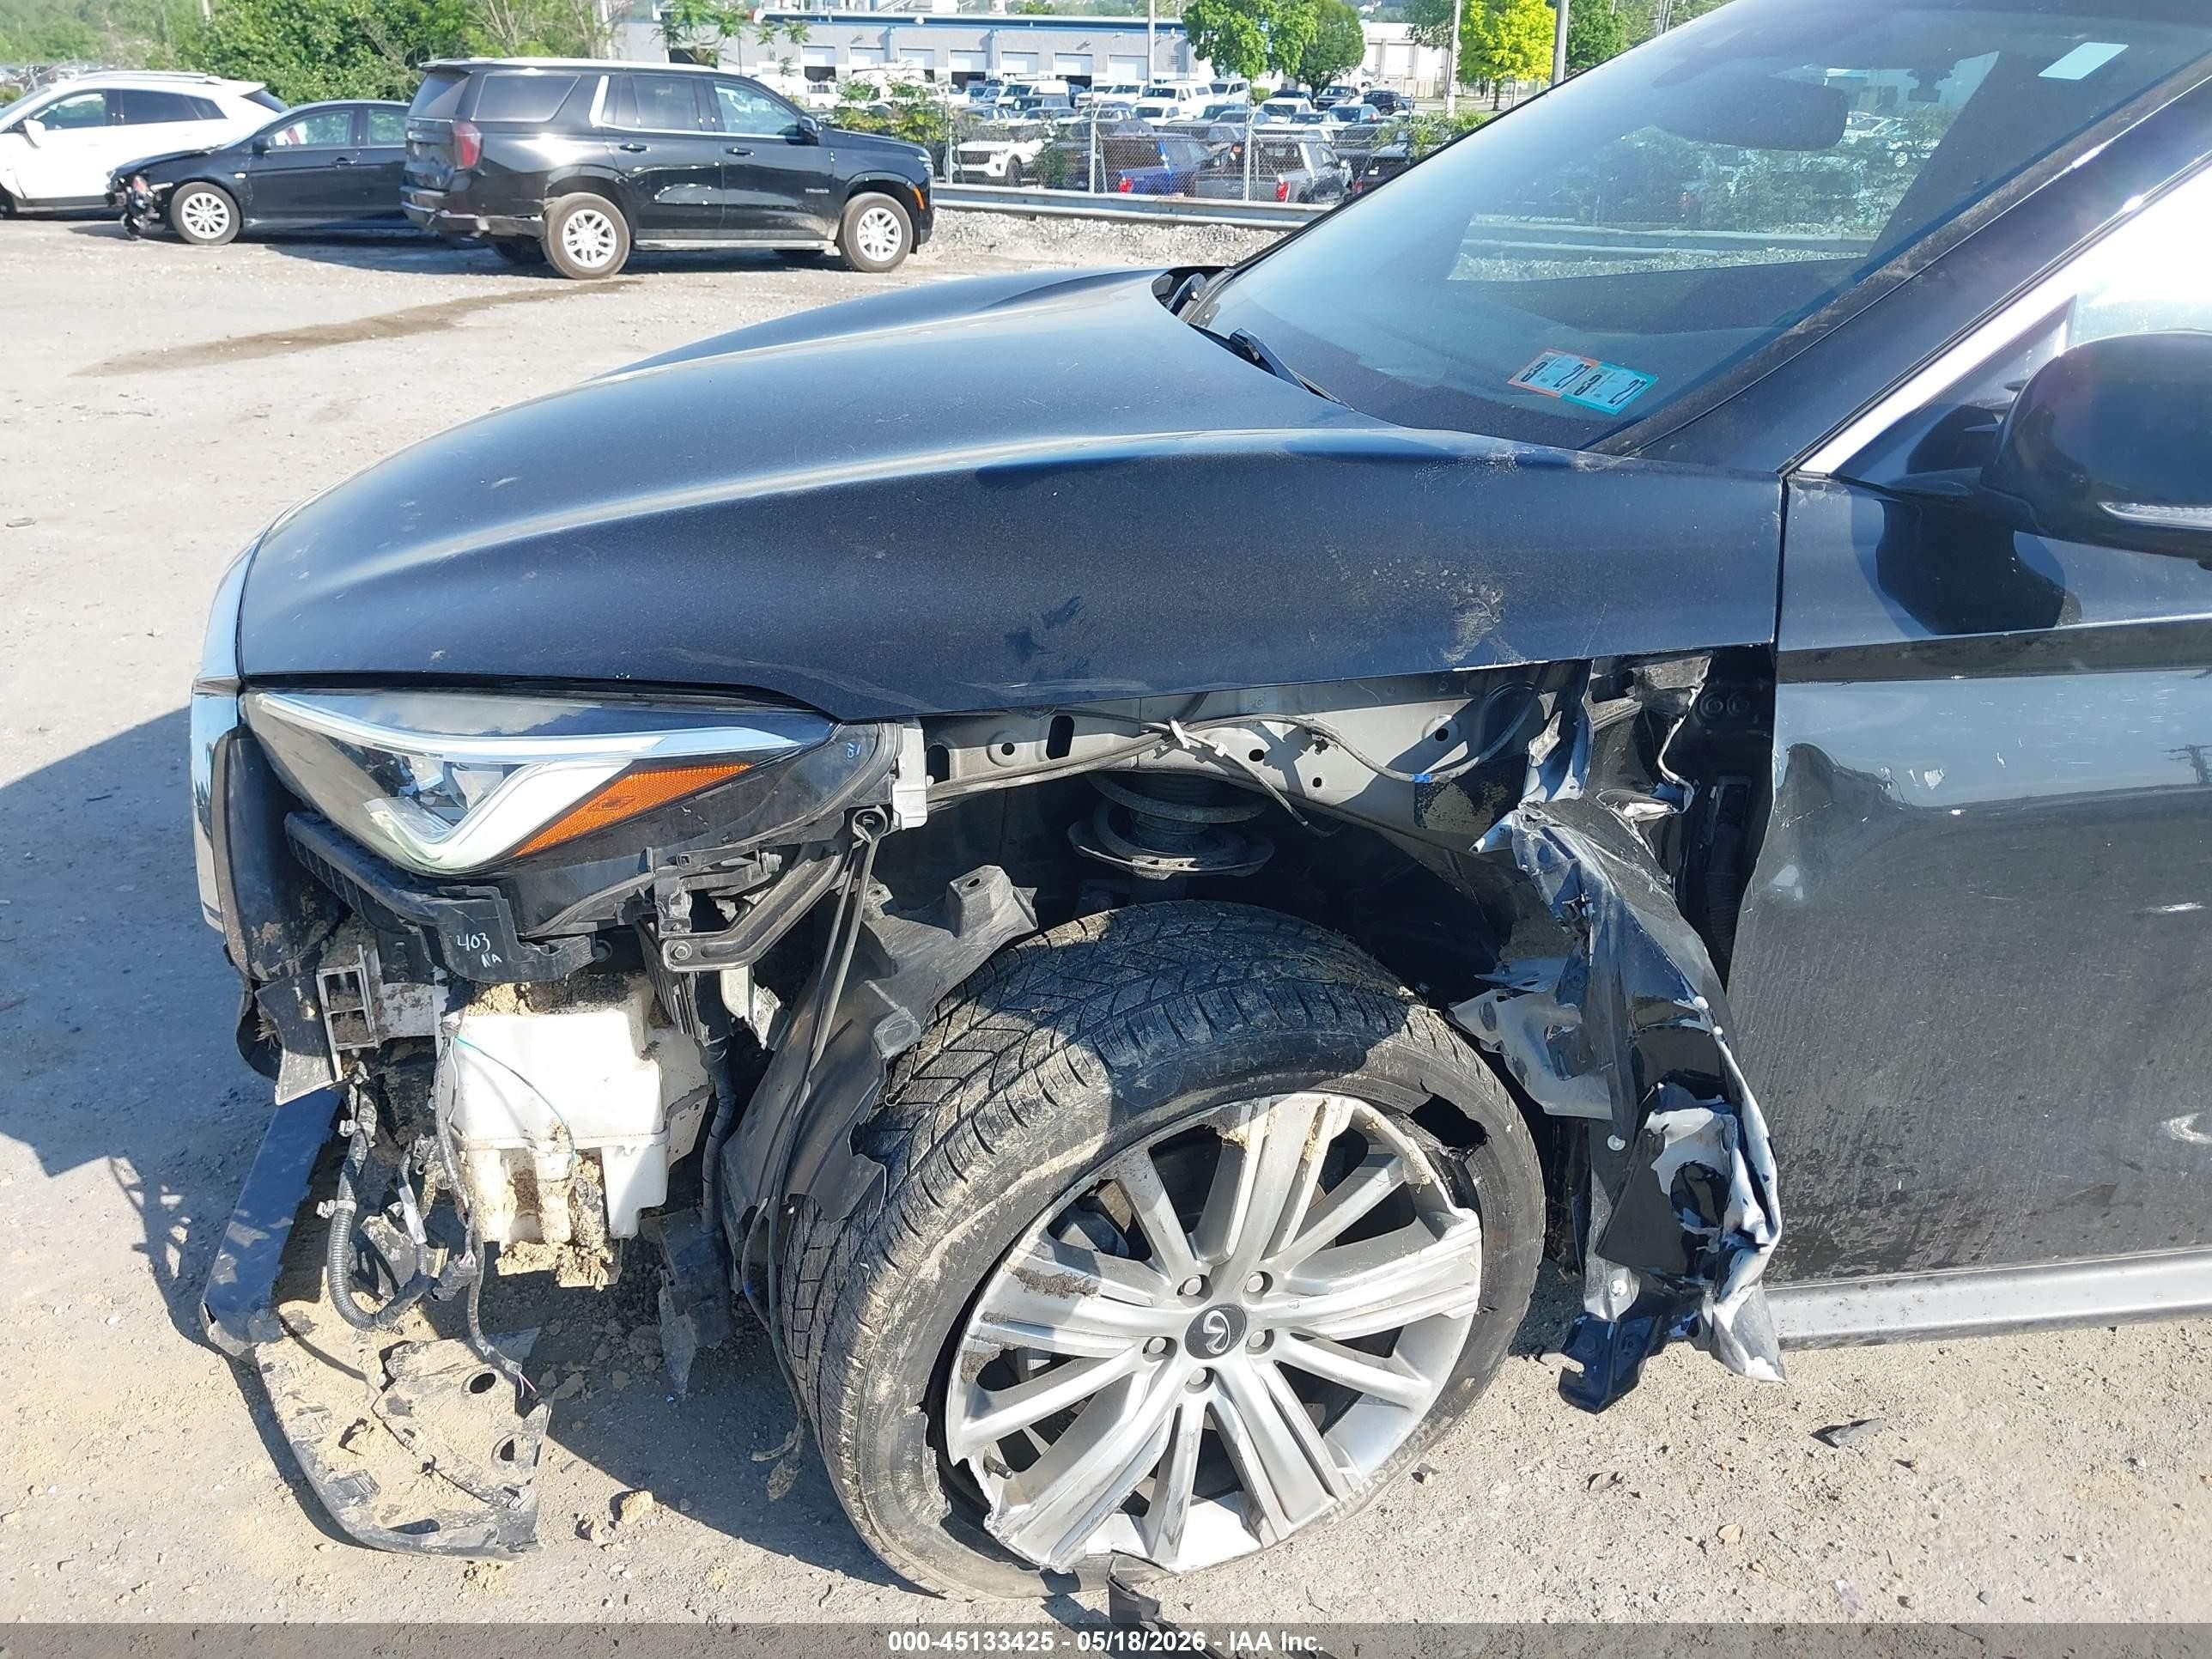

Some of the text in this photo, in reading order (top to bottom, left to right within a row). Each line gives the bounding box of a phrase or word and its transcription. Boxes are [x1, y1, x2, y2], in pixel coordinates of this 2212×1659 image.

[1553, 363, 1591, 391] 27
[1607, 379, 1647, 406] 27
[456, 932, 491, 953] 403
